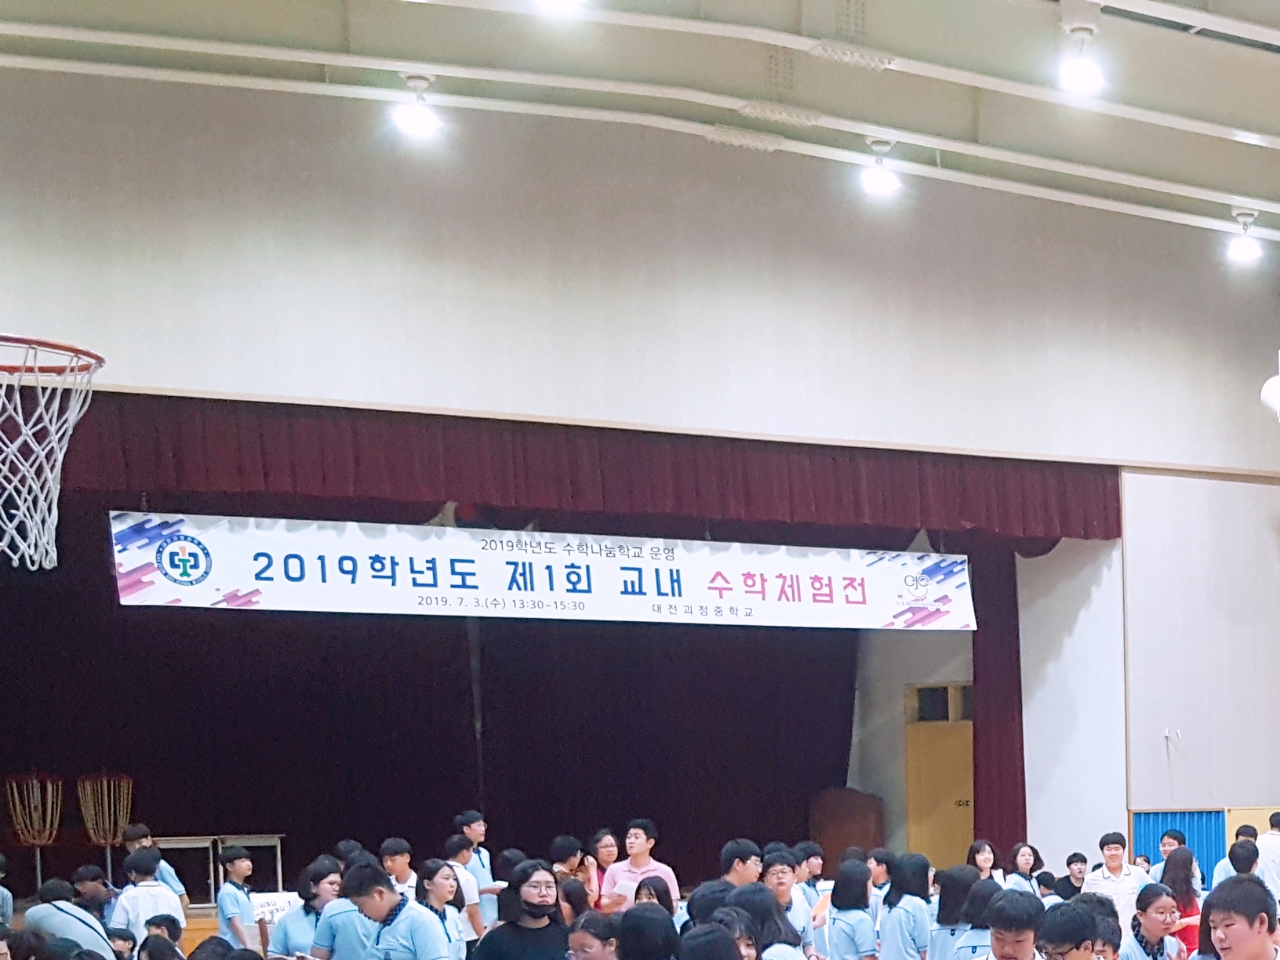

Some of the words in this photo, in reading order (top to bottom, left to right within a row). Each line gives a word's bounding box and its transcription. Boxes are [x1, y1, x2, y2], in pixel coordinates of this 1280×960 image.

[481, 540, 557, 555] 2019학년도
[562, 542, 646, 559] 수학나눔학교
[649, 546, 675, 561] 운영
[253, 552, 479, 590] 2019학년도
[505, 561, 593, 595] 제1회
[620, 566, 683, 598] 교내
[707, 571, 867, 606] 수학체험전
[418, 596, 452, 607] 2019.
[458, 598, 468, 608] 7.
[473, 598, 506, 610] 3.(수)
[512, 599, 586, 611] 13:30~15:30
